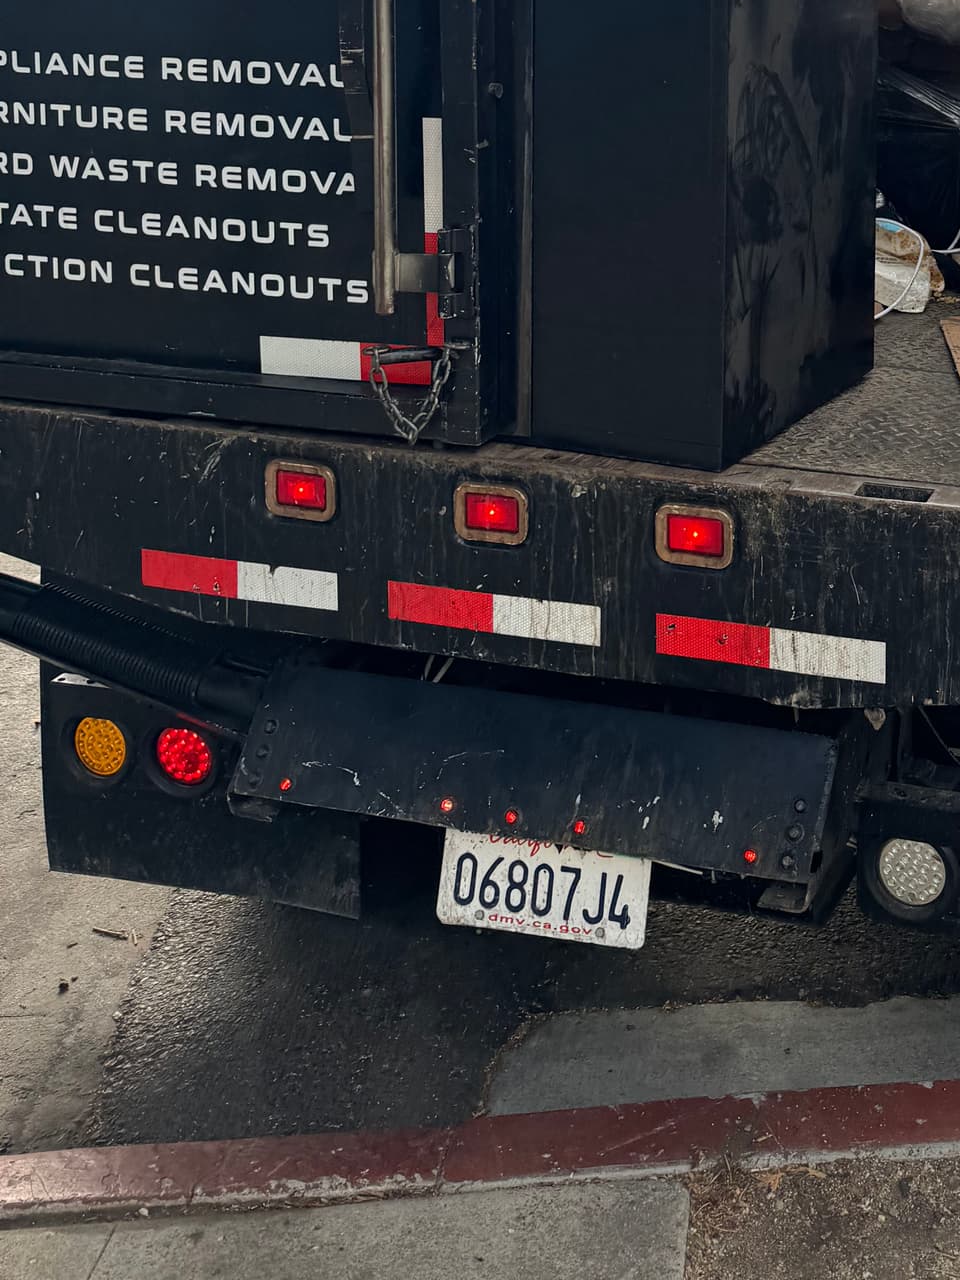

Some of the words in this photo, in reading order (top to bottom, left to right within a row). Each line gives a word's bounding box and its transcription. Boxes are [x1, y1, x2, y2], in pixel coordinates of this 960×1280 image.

[161, 56, 345, 88] REMOVAL
[165, 109, 352, 143] REMOVAL
[50, 154, 178, 186] WASTE
[94, 209, 330, 248] CLEANOUTS
[4, 253, 113, 284] CTION
[130, 263, 370, 304] CLEANOUTS
[453, 851, 631, 930] 06807J4
[488, 913, 593, 936] dmv.ca.gov
